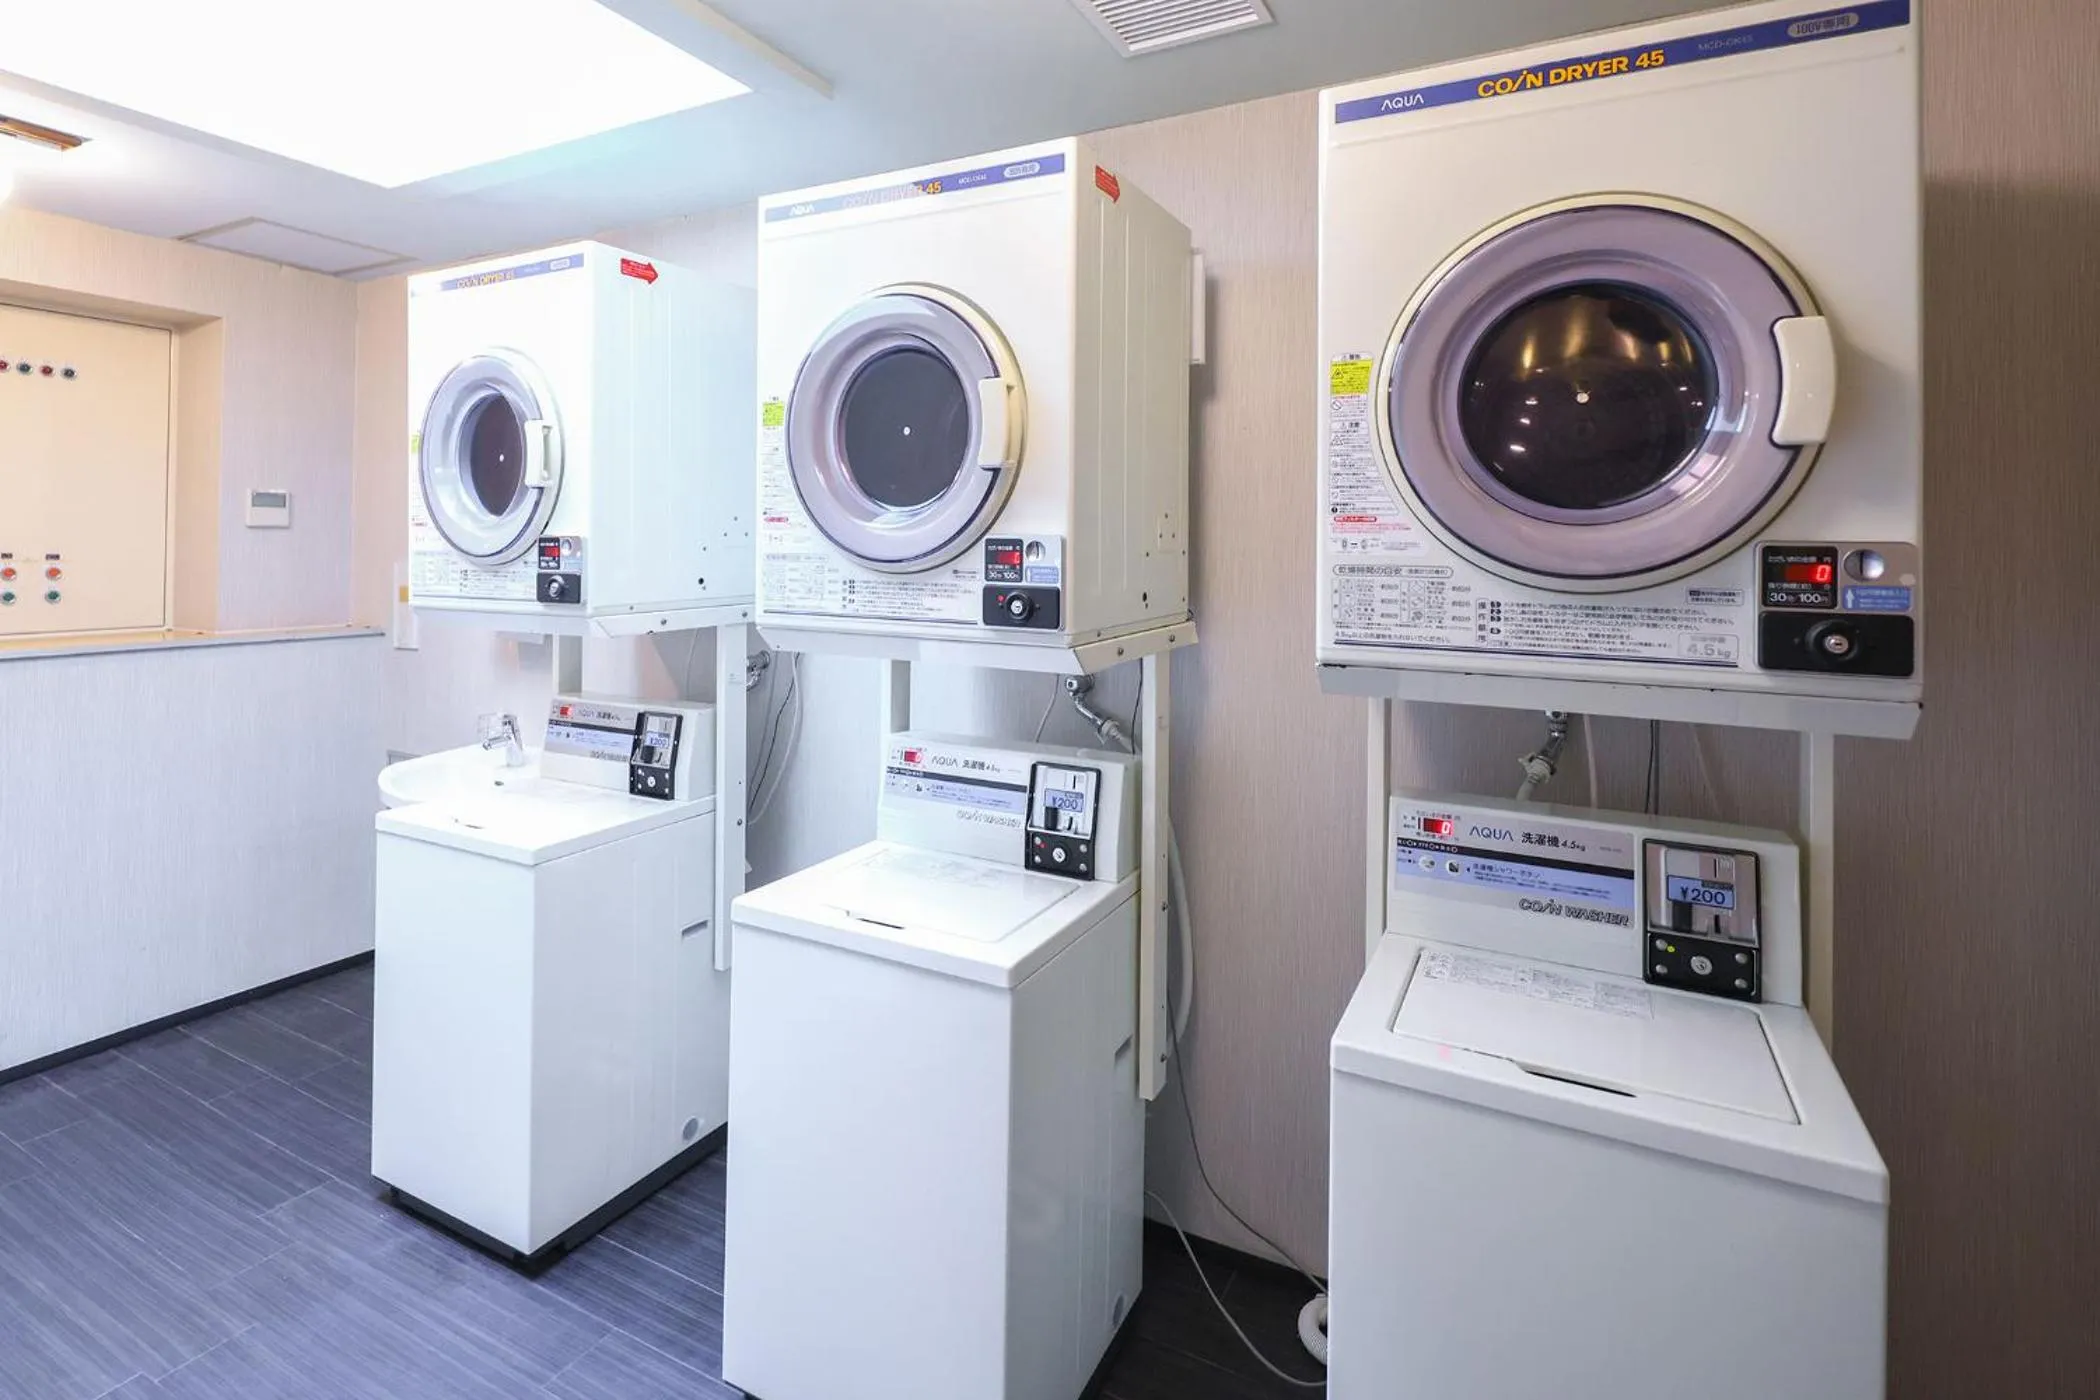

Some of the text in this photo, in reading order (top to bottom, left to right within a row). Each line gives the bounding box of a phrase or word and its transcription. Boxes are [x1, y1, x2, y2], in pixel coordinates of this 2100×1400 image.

[1549, 55, 1629, 85] DRYER
[1635, 49, 1666, 68] 45
[1380, 93, 1425, 112] AQUA
[926, 181, 942, 195] 45
[1816, 565, 1831, 581] 0
[1441, 821, 1451, 834] 0
[1469, 826, 1515, 843] AQUA
[1521, 831, 1560, 849] 洗濯機
[1679, 885, 1727, 906] ¥200
[1565, 906, 1630, 927] WASHER
